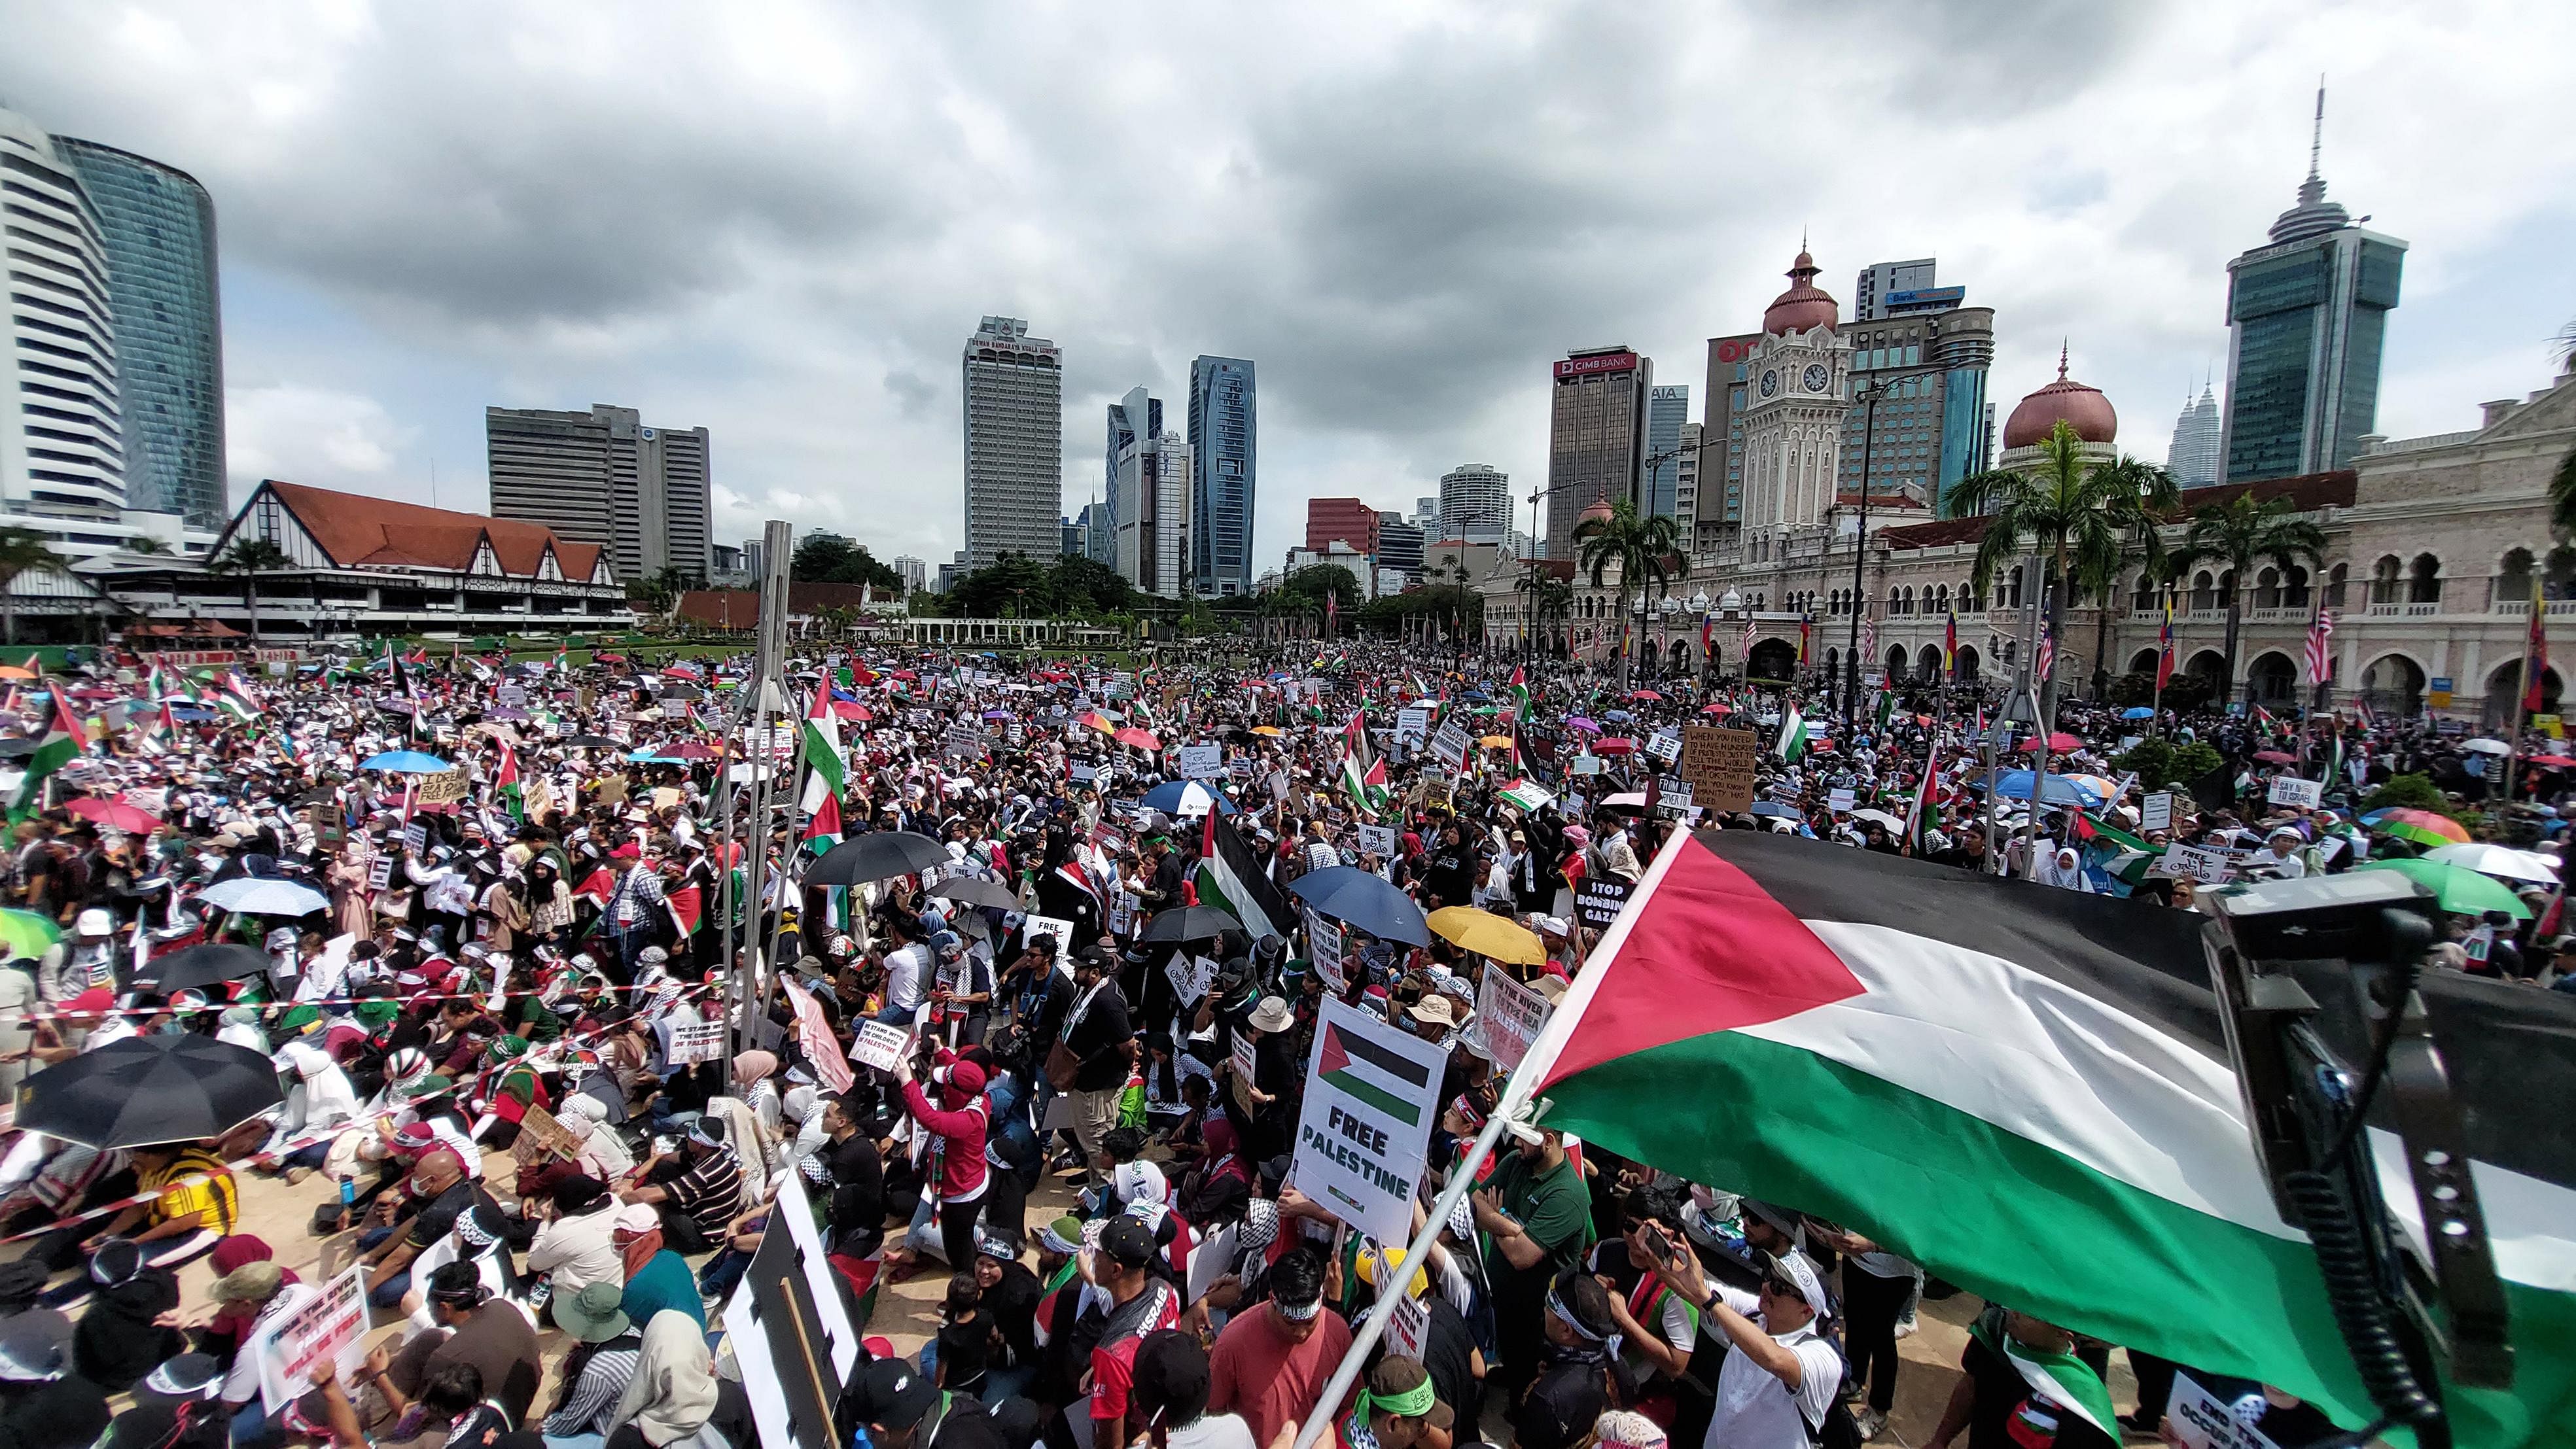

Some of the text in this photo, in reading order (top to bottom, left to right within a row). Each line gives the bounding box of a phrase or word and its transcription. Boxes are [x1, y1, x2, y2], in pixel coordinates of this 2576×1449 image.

[972, 339, 991, 348] DEWAN
[991, 341, 1020, 351] BANDARAYA
[1575, 358, 1627, 370] CIMB BANK
[1651, 387, 1677, 399] AIA
[1441, 724, 1465, 741] MALAYS
[1689, 732, 1751, 744] WHEN YOU NEED
[1653, 736, 1668, 754] SAVE
[1662, 740, 1677, 758] GAZA
[1721, 744, 1756, 753] HUNDREDS
[1698, 750, 1726, 759] PROTESTS
[1725, 759, 1750, 768] WORLD
[433, 784, 441, 792] A
[1659, 778, 1693, 796] FROM THE
[1695, 788, 1727, 797] UMANITY
[1726, 783, 1746, 792] KNOW
[2278, 782, 2293, 790] SAY
[420, 791, 443, 801] FREE
[1662, 794, 1688, 808] RIVER TO
[1694, 797, 1716, 806] AILED
[2278, 791, 2311, 805] TO ISRAEL
[1656, 806, 1686, 822] THE SEA
[1366, 829, 1382, 837] FREE
[2181, 850, 2206, 862] FREE
[955, 867, 969, 877] FREE
[1591, 881, 1623, 897] STOP
[1577, 894, 1624, 912] BOMBIN
[1038, 922, 1059, 932] FREE
[1205, 964, 1219, 975] FRE
[1488, 971, 1543, 1017] FROM THE RIVER
[1507, 1001, 1521, 1019] THE
[1522, 1012, 1540, 1032] SEA
[870, 1025, 888, 1034] STAND
[888, 1031, 905, 1042] WITH
[871, 1033, 899, 1047] CHILDREN
[687, 1038, 724, 1047] PALESTIN
[864, 1039, 897, 1056] PALESTINE
[1328, 1105, 1388, 1157] FREE
[1301, 1123, 1411, 1202] PALESTINE
[269, 1273, 357, 1346] FROM THE RIVER
[294, 1285, 359, 1338] TO THE SEA
[1135, 1285, 1168, 1340] #ISRAEL
[1284, 1299, 1320, 1318] PALESTINE
[1401, 1295, 1423, 1327] WITH
[1394, 1304, 1417, 1336] DREN
[1390, 1314, 1419, 1354] STINE
[283, 1351, 315, 1380] WILL
[334, 1308, 363, 1340] FREE
[2200, 1399, 2230, 1428] END
[2179, 1402, 2243, 1449] OCCUPA
